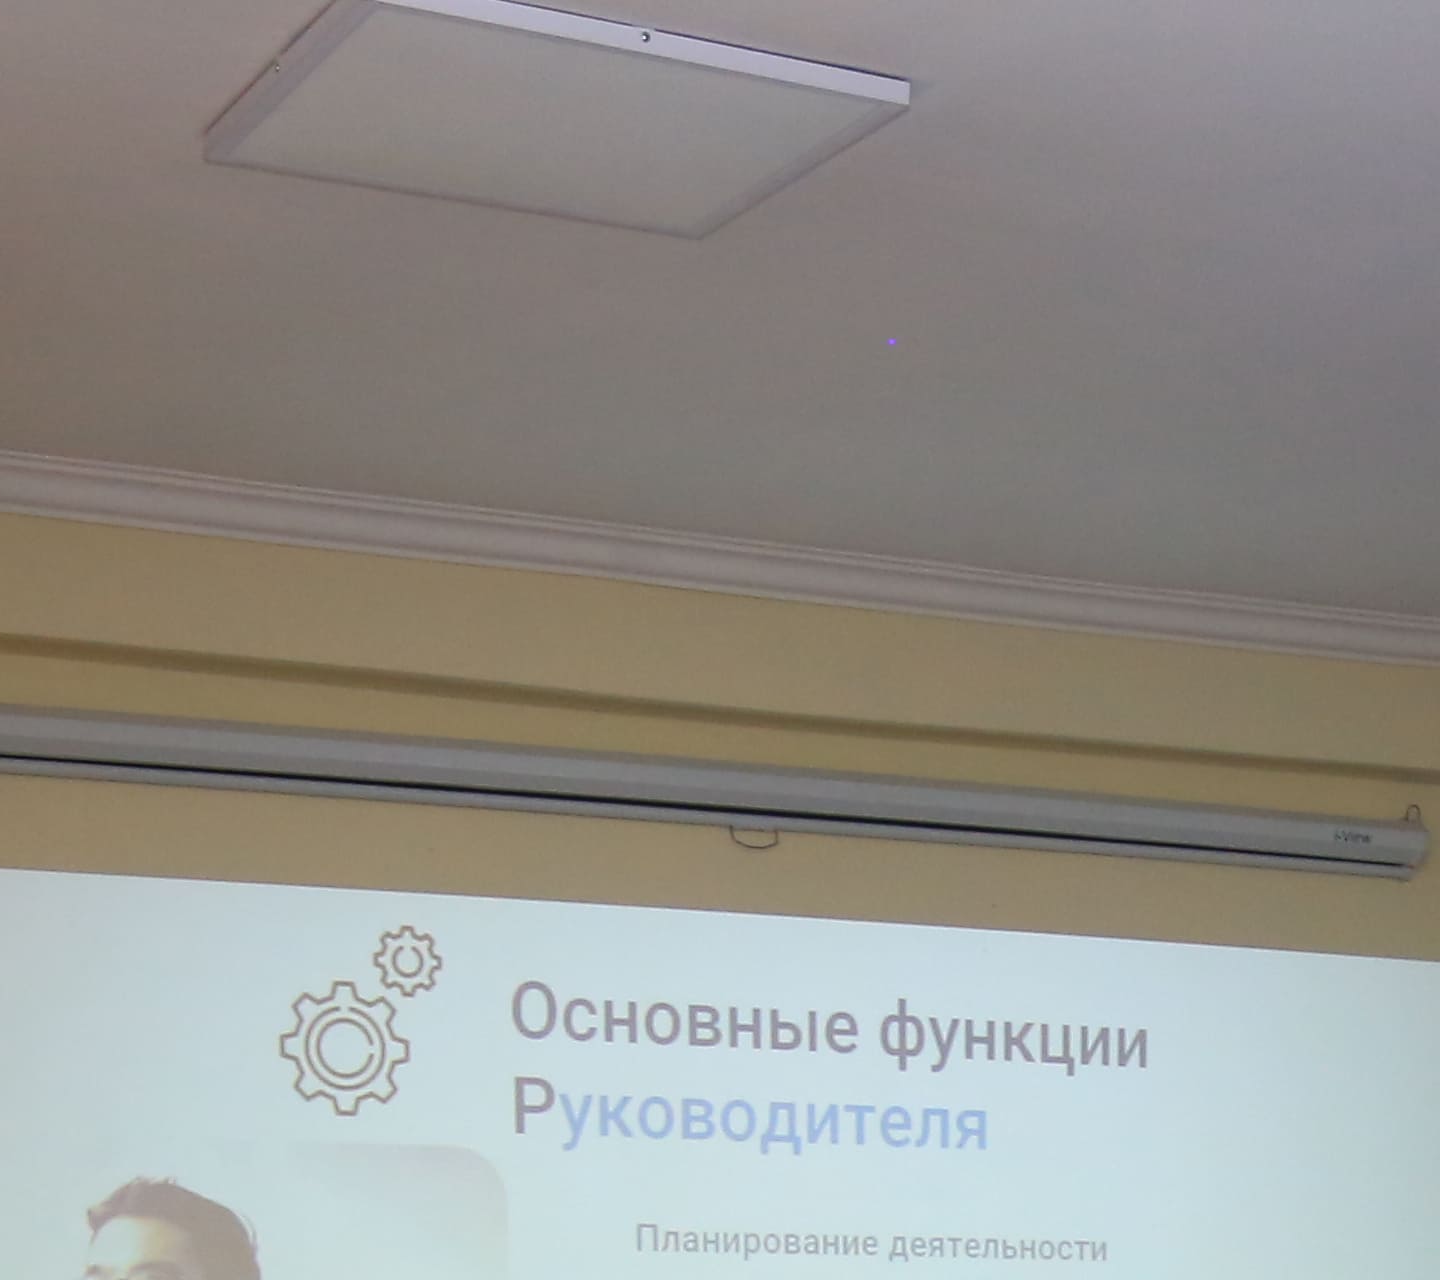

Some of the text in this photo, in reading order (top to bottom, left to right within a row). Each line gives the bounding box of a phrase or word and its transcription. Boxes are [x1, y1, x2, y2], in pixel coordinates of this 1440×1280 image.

[511, 979, 1149, 1076] Основные функции
[513, 1076, 989, 1155] Руководителя
[635, 1223, 1108, 1264] Планирование деятельности
